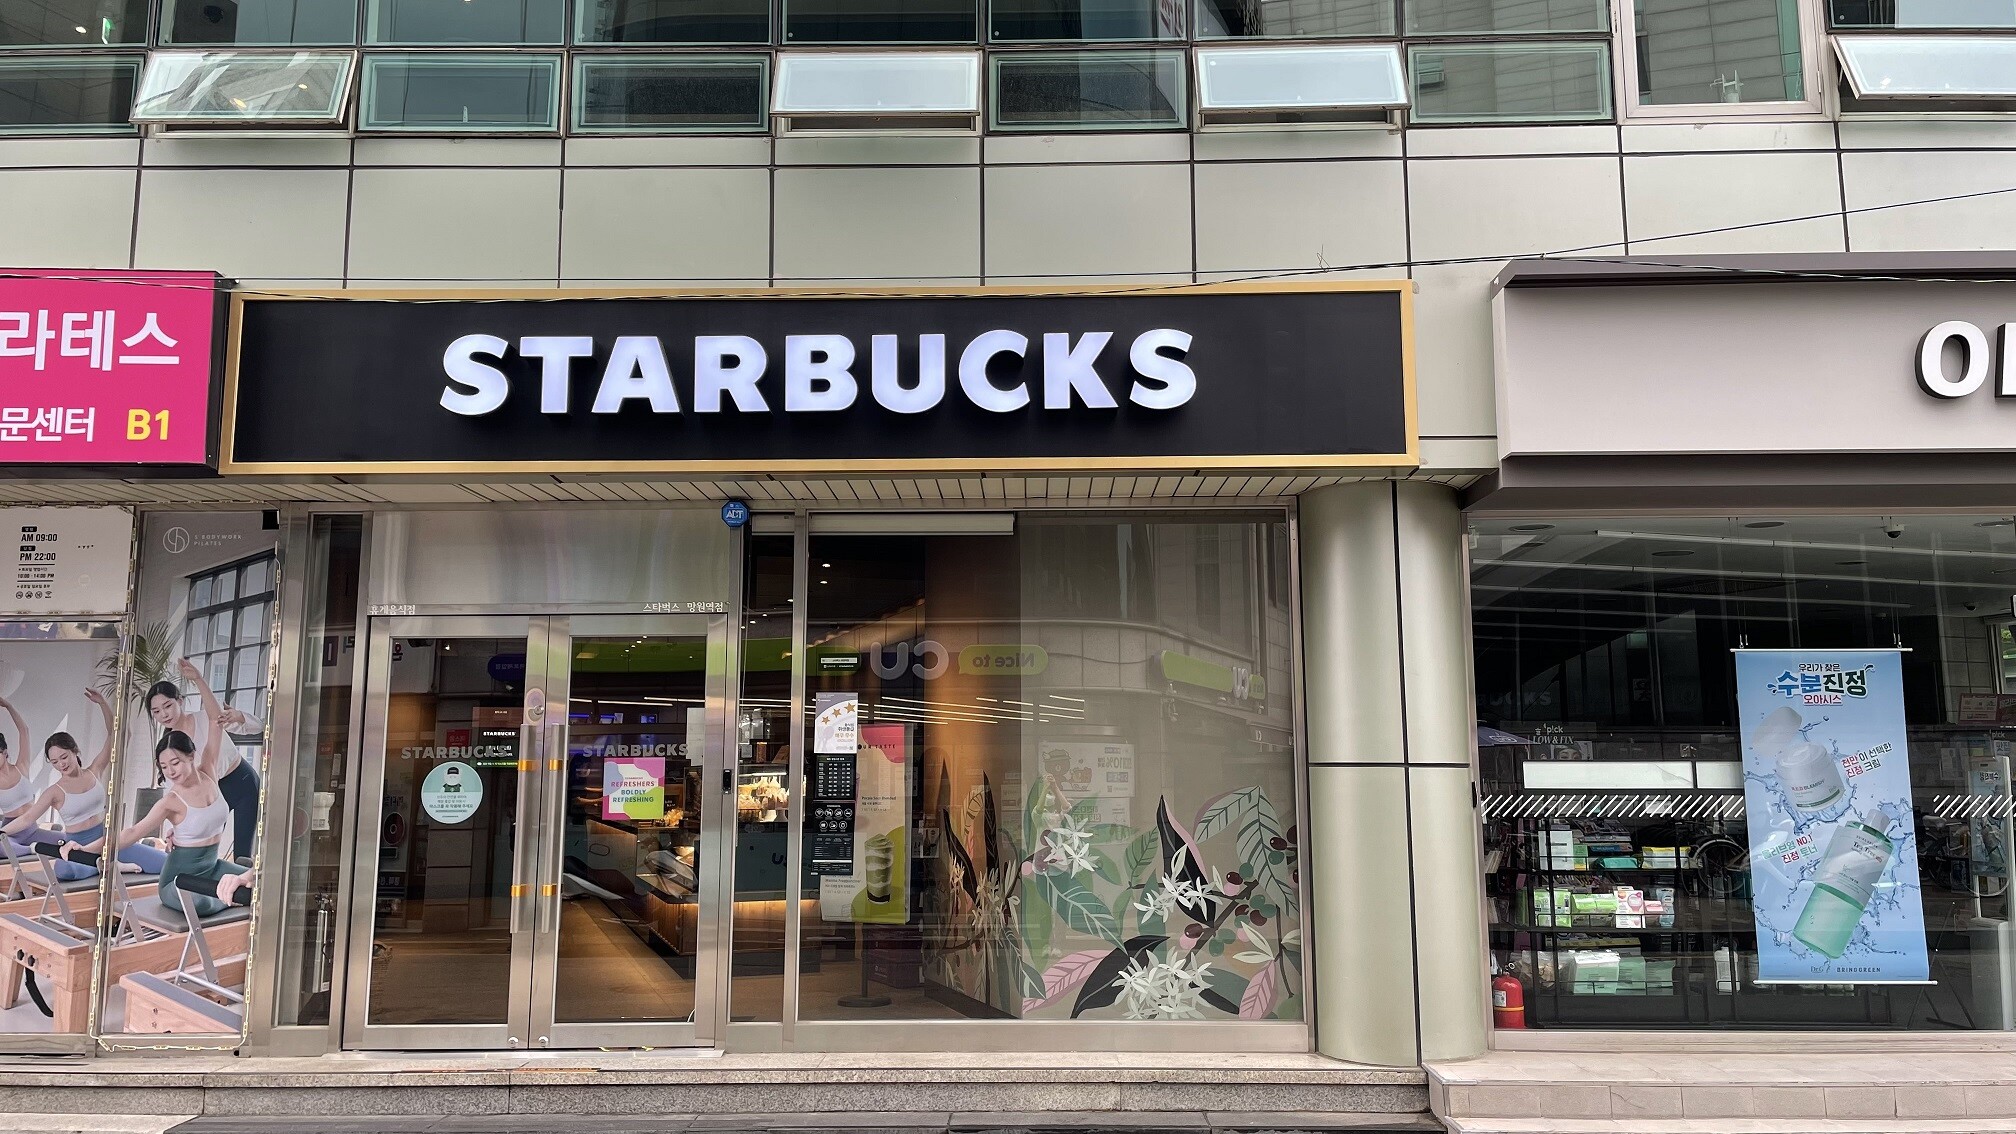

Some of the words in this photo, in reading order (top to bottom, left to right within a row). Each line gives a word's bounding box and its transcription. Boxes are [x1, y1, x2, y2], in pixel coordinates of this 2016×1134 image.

[438, 328, 1199, 417] STARBUCKS
[0, 407, 95, 442] 문센터
[126, 408, 170, 441] B1
[21, 533, 34, 542] AM
[35, 533, 58, 542] 09:00
[19, 552, 32, 561] PM
[34, 552, 56, 561] 22:00
[642, 602, 681, 613] 스타벅스
[686, 601, 724, 612] 망원역점
[1798, 663, 1823, 672] 우리가
[1824, 663, 1841, 672] 찾은
[1776, 669, 1868, 697] 수분진정
[1803, 694, 1842, 704] 오아시스
[400, 745, 508, 760] STARBUCKS
[582, 743, 690, 758] STARBUCKS
[1868, 741, 1893, 758] 선택한
[1846, 765, 1864, 778] 진정
[1863, 758, 1882, 772] 크림
[610, 780, 655, 788] REFRESHERS
[1781, 850, 1800, 864] 진정
